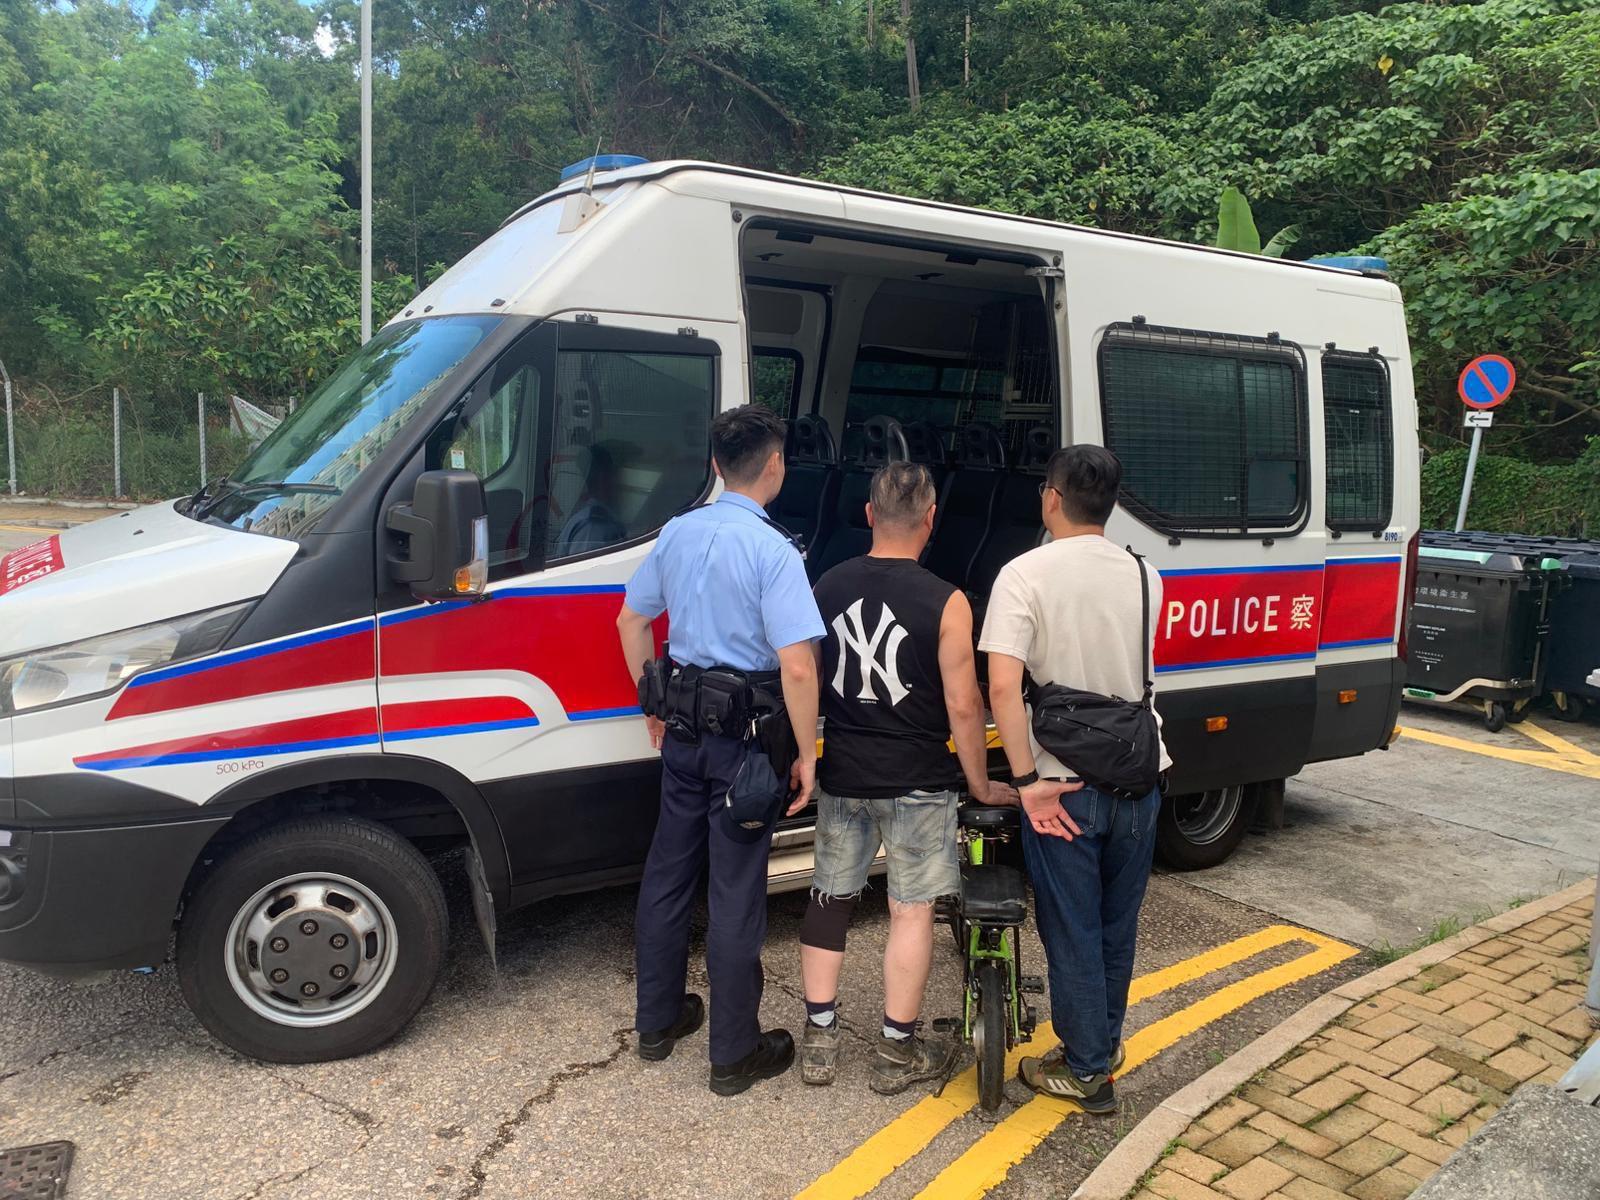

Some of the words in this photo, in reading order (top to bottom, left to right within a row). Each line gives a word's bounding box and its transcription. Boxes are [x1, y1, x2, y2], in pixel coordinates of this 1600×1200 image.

[1165, 595, 1281, 640] POLICE
[1290, 593, 1315, 631] 察
[831, 597, 911, 706] NY
[216, 762, 239, 776] 500
[241, 760, 264, 771] kPa
